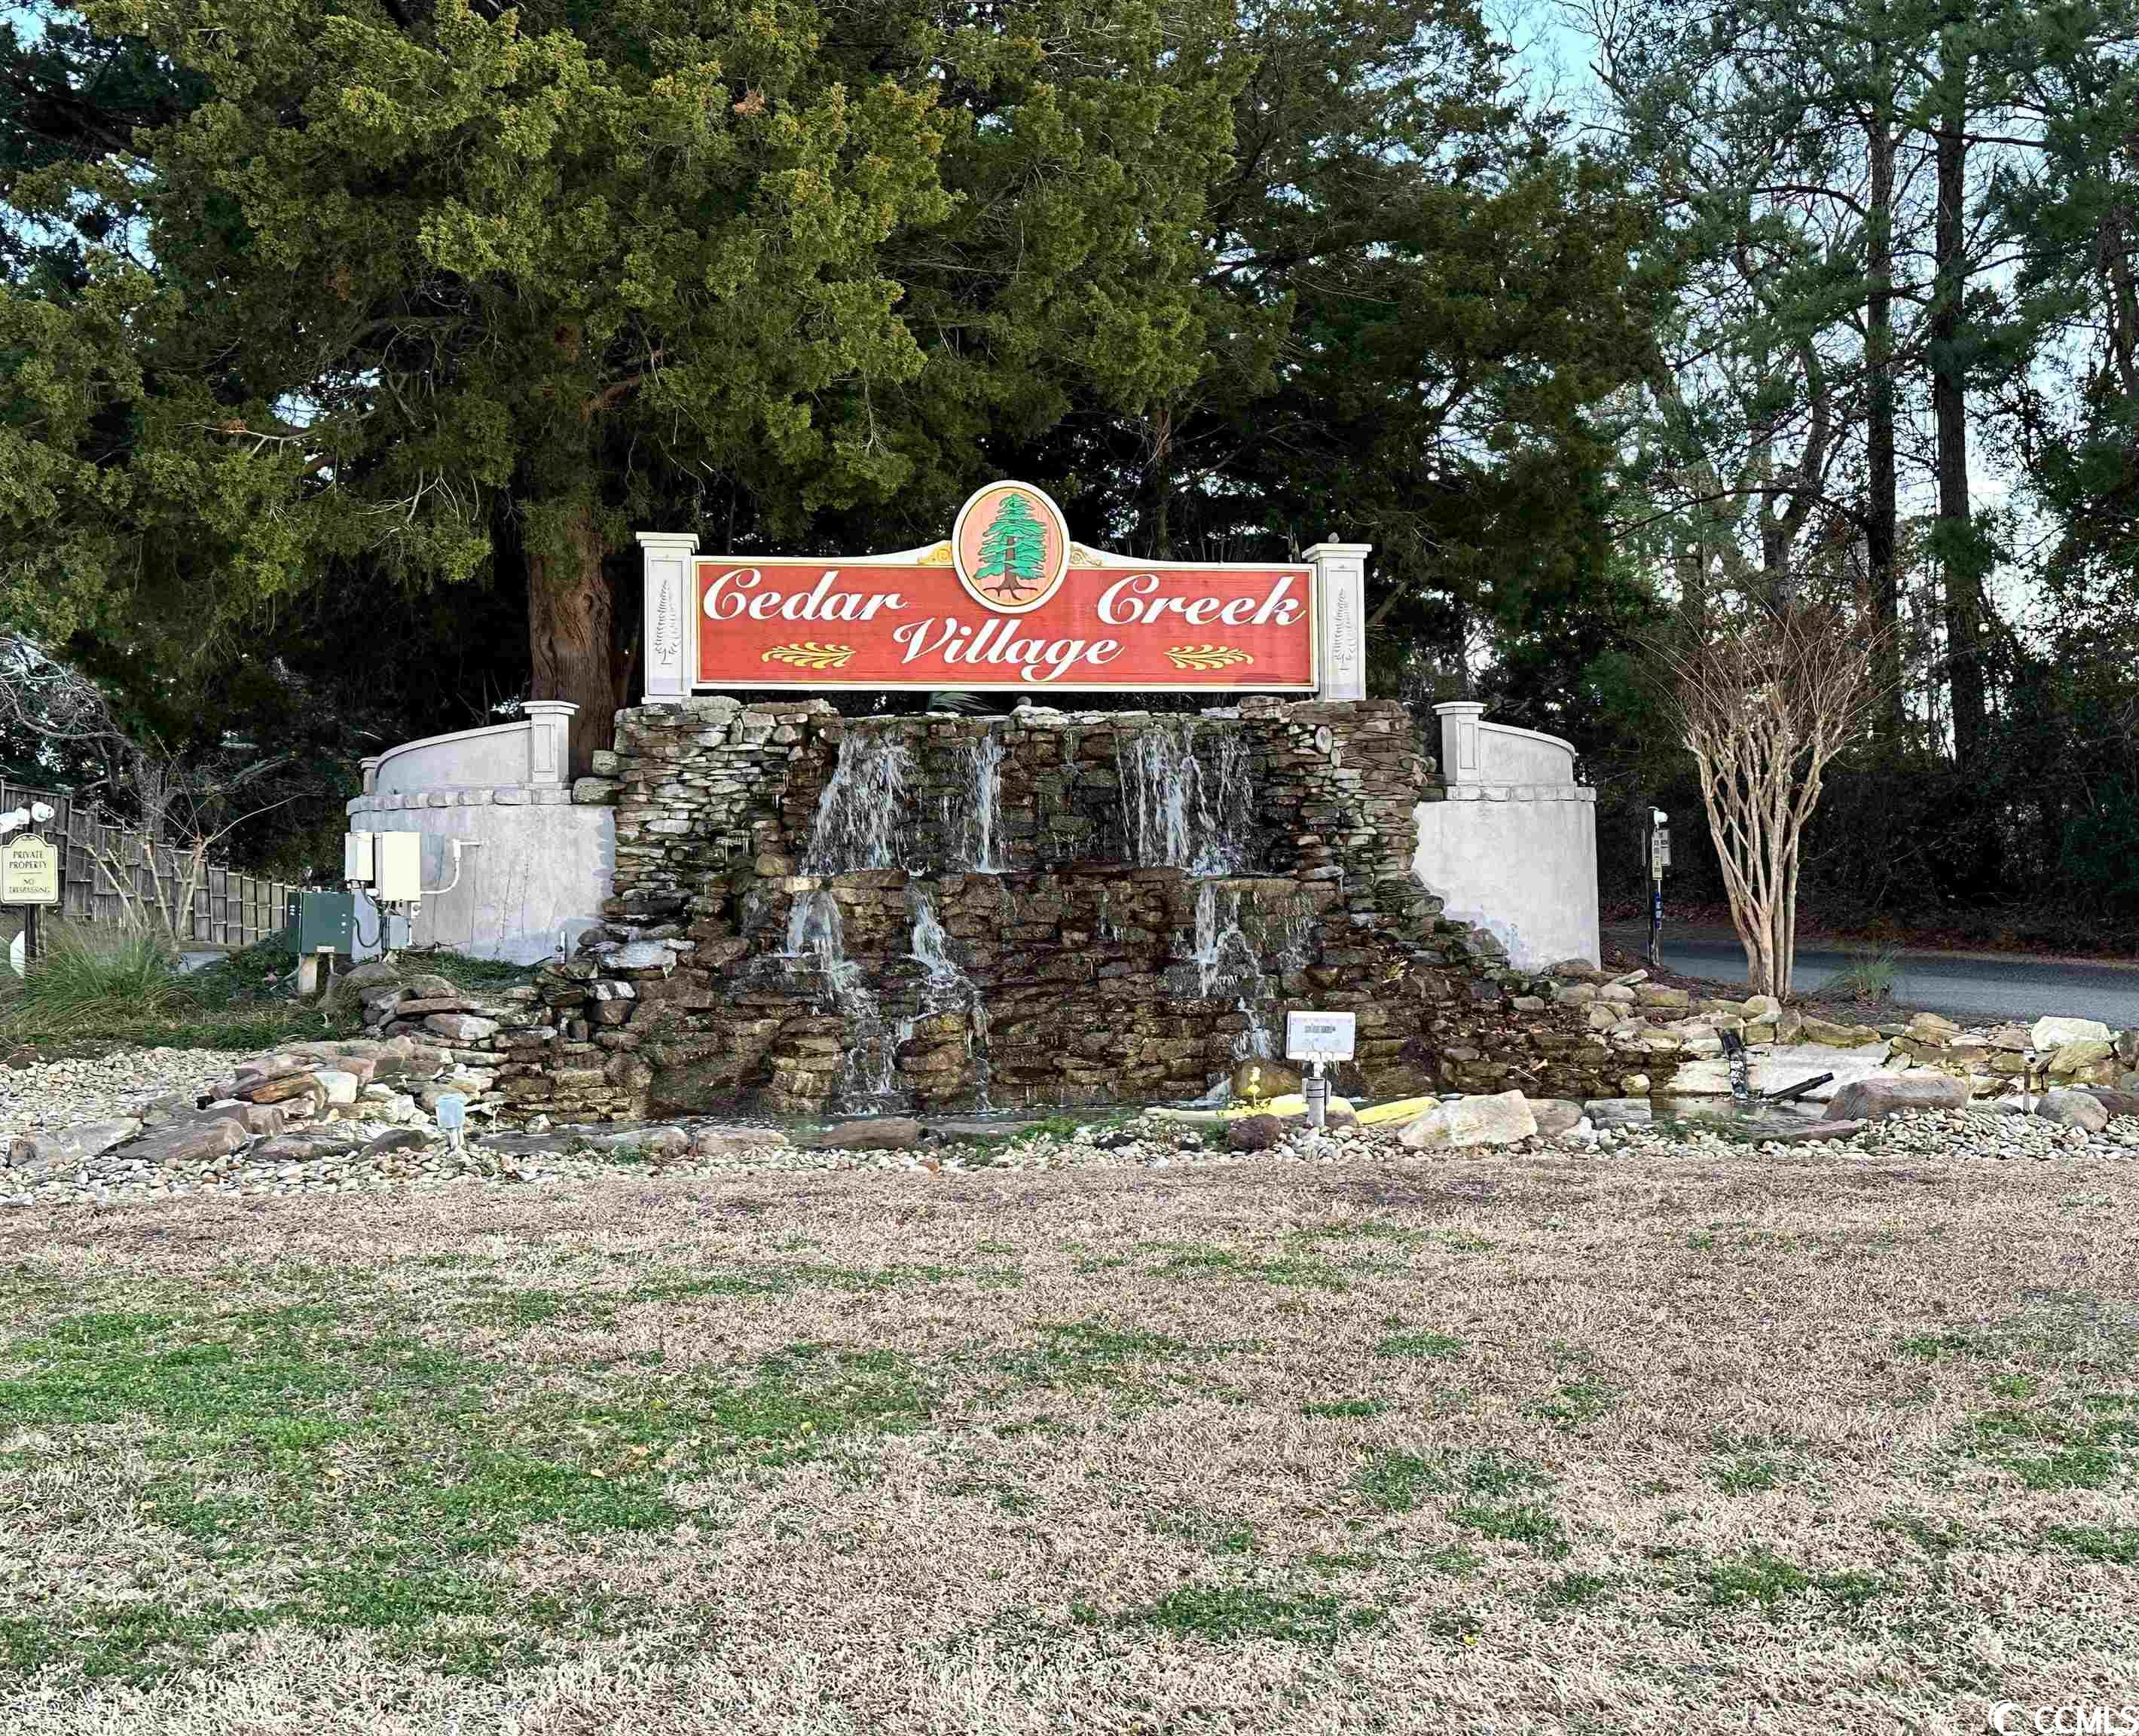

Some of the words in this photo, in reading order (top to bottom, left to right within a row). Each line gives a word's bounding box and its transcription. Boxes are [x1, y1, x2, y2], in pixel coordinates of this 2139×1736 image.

[703, 567, 909, 622] Cedar
[1096, 573, 1306, 626] Creek
[892, 618, 1125, 682] Village
[13, 851, 44, 859] PRIVATE
